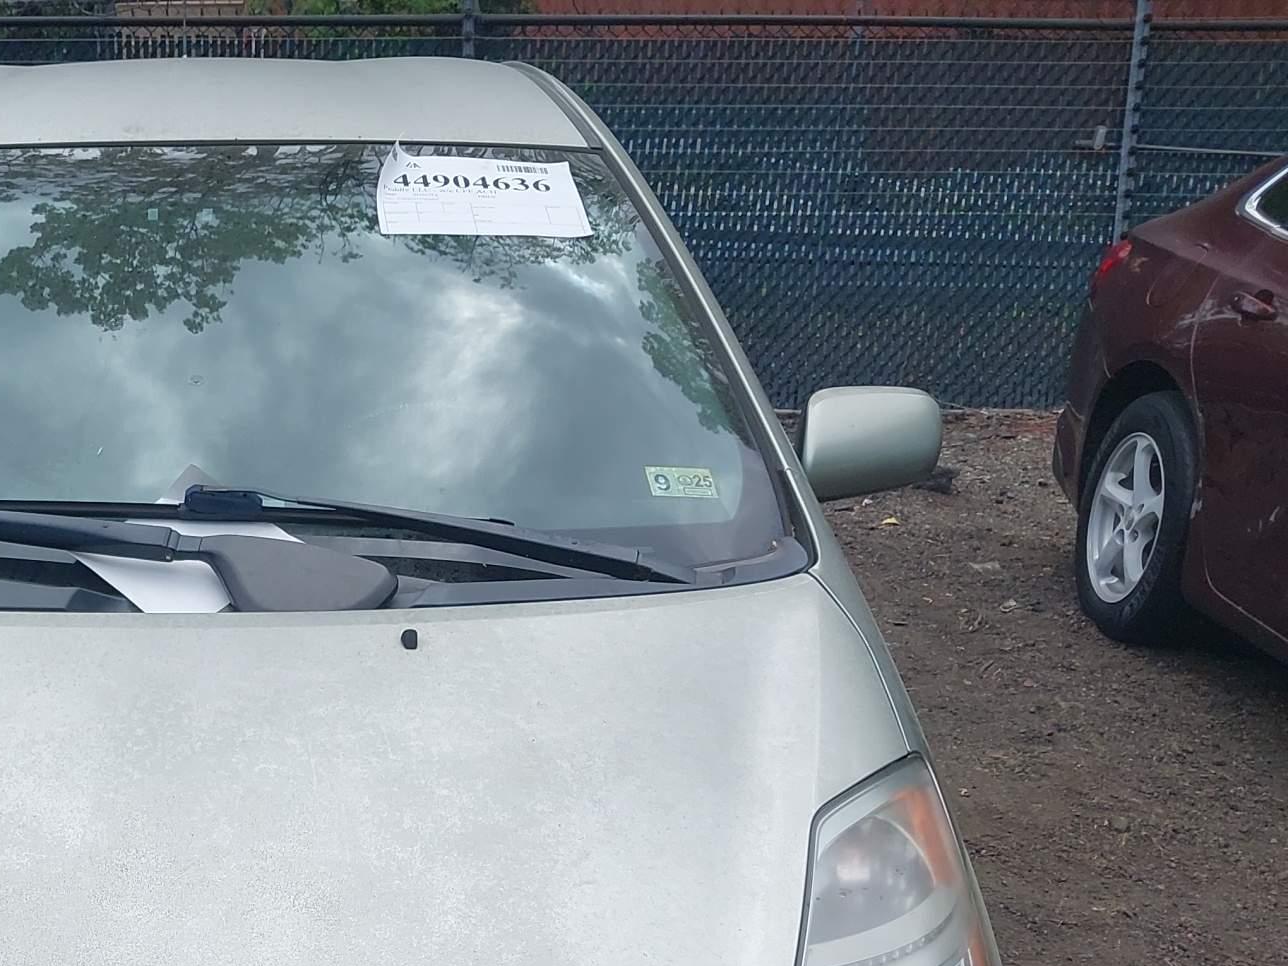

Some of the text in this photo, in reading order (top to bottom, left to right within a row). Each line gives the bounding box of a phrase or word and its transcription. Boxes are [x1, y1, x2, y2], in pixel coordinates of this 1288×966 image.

[393, 173, 551, 193] 44904636
[654, 473, 713, 491] 9 25
